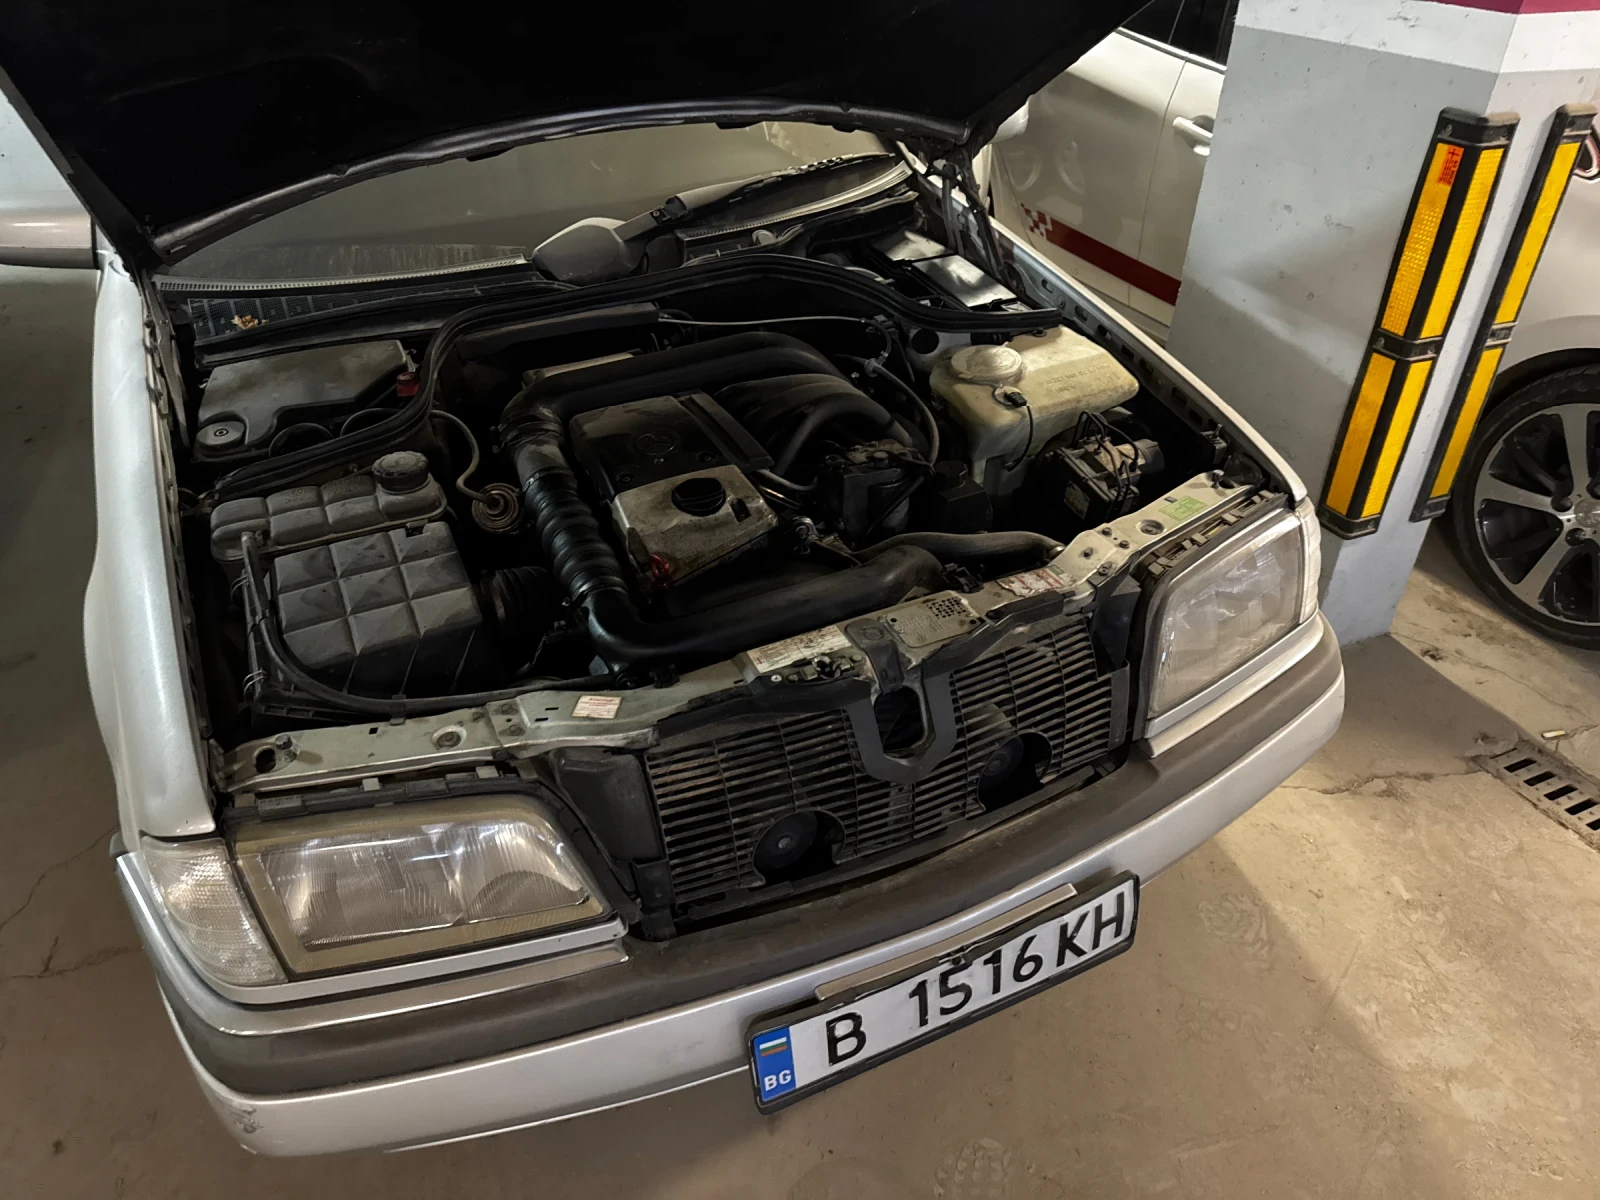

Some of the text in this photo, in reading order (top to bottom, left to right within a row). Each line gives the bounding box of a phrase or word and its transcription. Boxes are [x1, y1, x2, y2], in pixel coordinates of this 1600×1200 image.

[827, 892, 1125, 1065] B 1516 KH
[764, 1069, 792, 1091] BG
